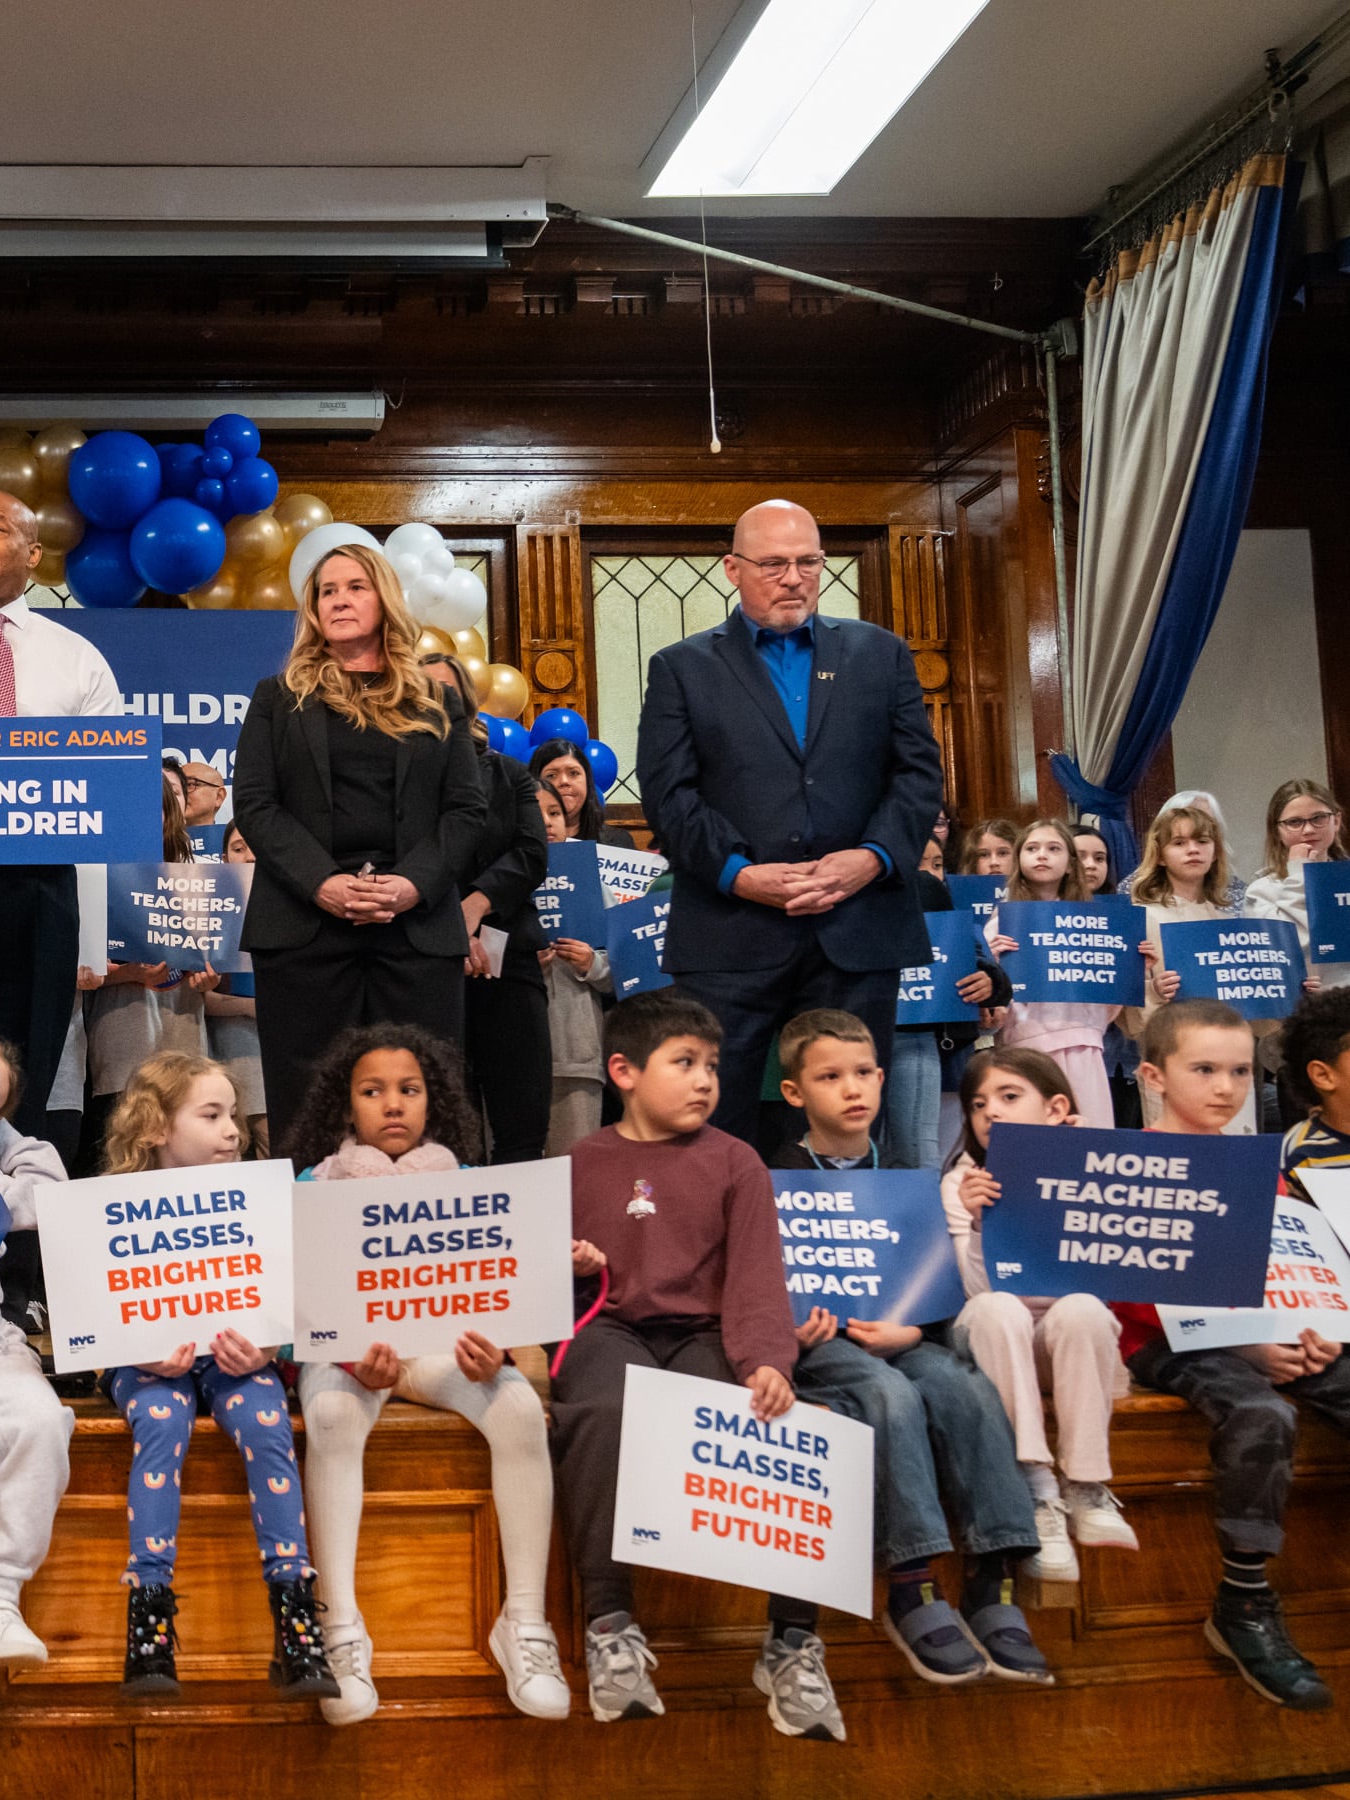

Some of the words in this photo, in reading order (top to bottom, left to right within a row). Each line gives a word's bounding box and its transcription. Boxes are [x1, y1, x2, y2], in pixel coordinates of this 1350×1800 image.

[121, 693, 251, 725] HILDR
[10, 731, 59, 747] ERIC
[66, 730, 147, 747] ADAMS
[52, 780, 87, 804] IN
[597, 857, 661, 878] SMALLE
[157, 877, 216, 893] MORE
[131, 892, 242, 914] TEACHERS,
[148, 913, 223, 931] BIGGER
[1055, 915, 1108, 930] MORE
[147, 930, 223, 950] IMPACT
[1029, 933, 1128, 951] TEACHERS,
[1219, 932, 1271, 946] MORE
[1049, 951, 1115, 966] BIGGER
[1194, 949, 1291, 967] TEACHERS,
[1048, 968, 1116, 984] IMPACT
[1215, 968, 1283, 982] BIGGER
[898, 986, 935, 1001] ACT
[1217, 985, 1287, 1001] IMPACT
[1085, 1151, 1190, 1181] MORE
[105, 1189, 247, 1225] SMALLER
[774, 1191, 855, 1212] MORE
[1036, 1177, 1228, 1217] TEACHERS,
[362, 1193, 511, 1227] SMALLER
[778, 1218, 900, 1244] ACHERS,
[1063, 1210, 1195, 1242] BIGGER
[109, 1222, 254, 1258] CLASSES,
[362, 1226, 513, 1259] CLASSES,
[782, 1245, 876, 1267] IGGER
[1058, 1239, 1194, 1272] IMPACT
[107, 1253, 264, 1292] BRIGHTER
[356, 1257, 518, 1291] BRIGHTER
[996, 1262, 1022, 1274] NYC
[785, 1273, 882, 1296] MPACT
[120, 1286, 262, 1324] FUTURES
[366, 1289, 510, 1323] FUTURES
[1265, 1290, 1348, 1311] TURES
[1179, 1318, 1207, 1328] NYC
[69, 1335, 96, 1346] NYC
[310, 1331, 338, 1340] NYC
[694, 1406, 829, 1460] SMALLER
[691, 1441, 829, 1498] CLASSES,
[684, 1472, 833, 1529] BRIGHTER
[632, 1527, 660, 1541] NYC
[691, 1508, 825, 1562] FUTURES
